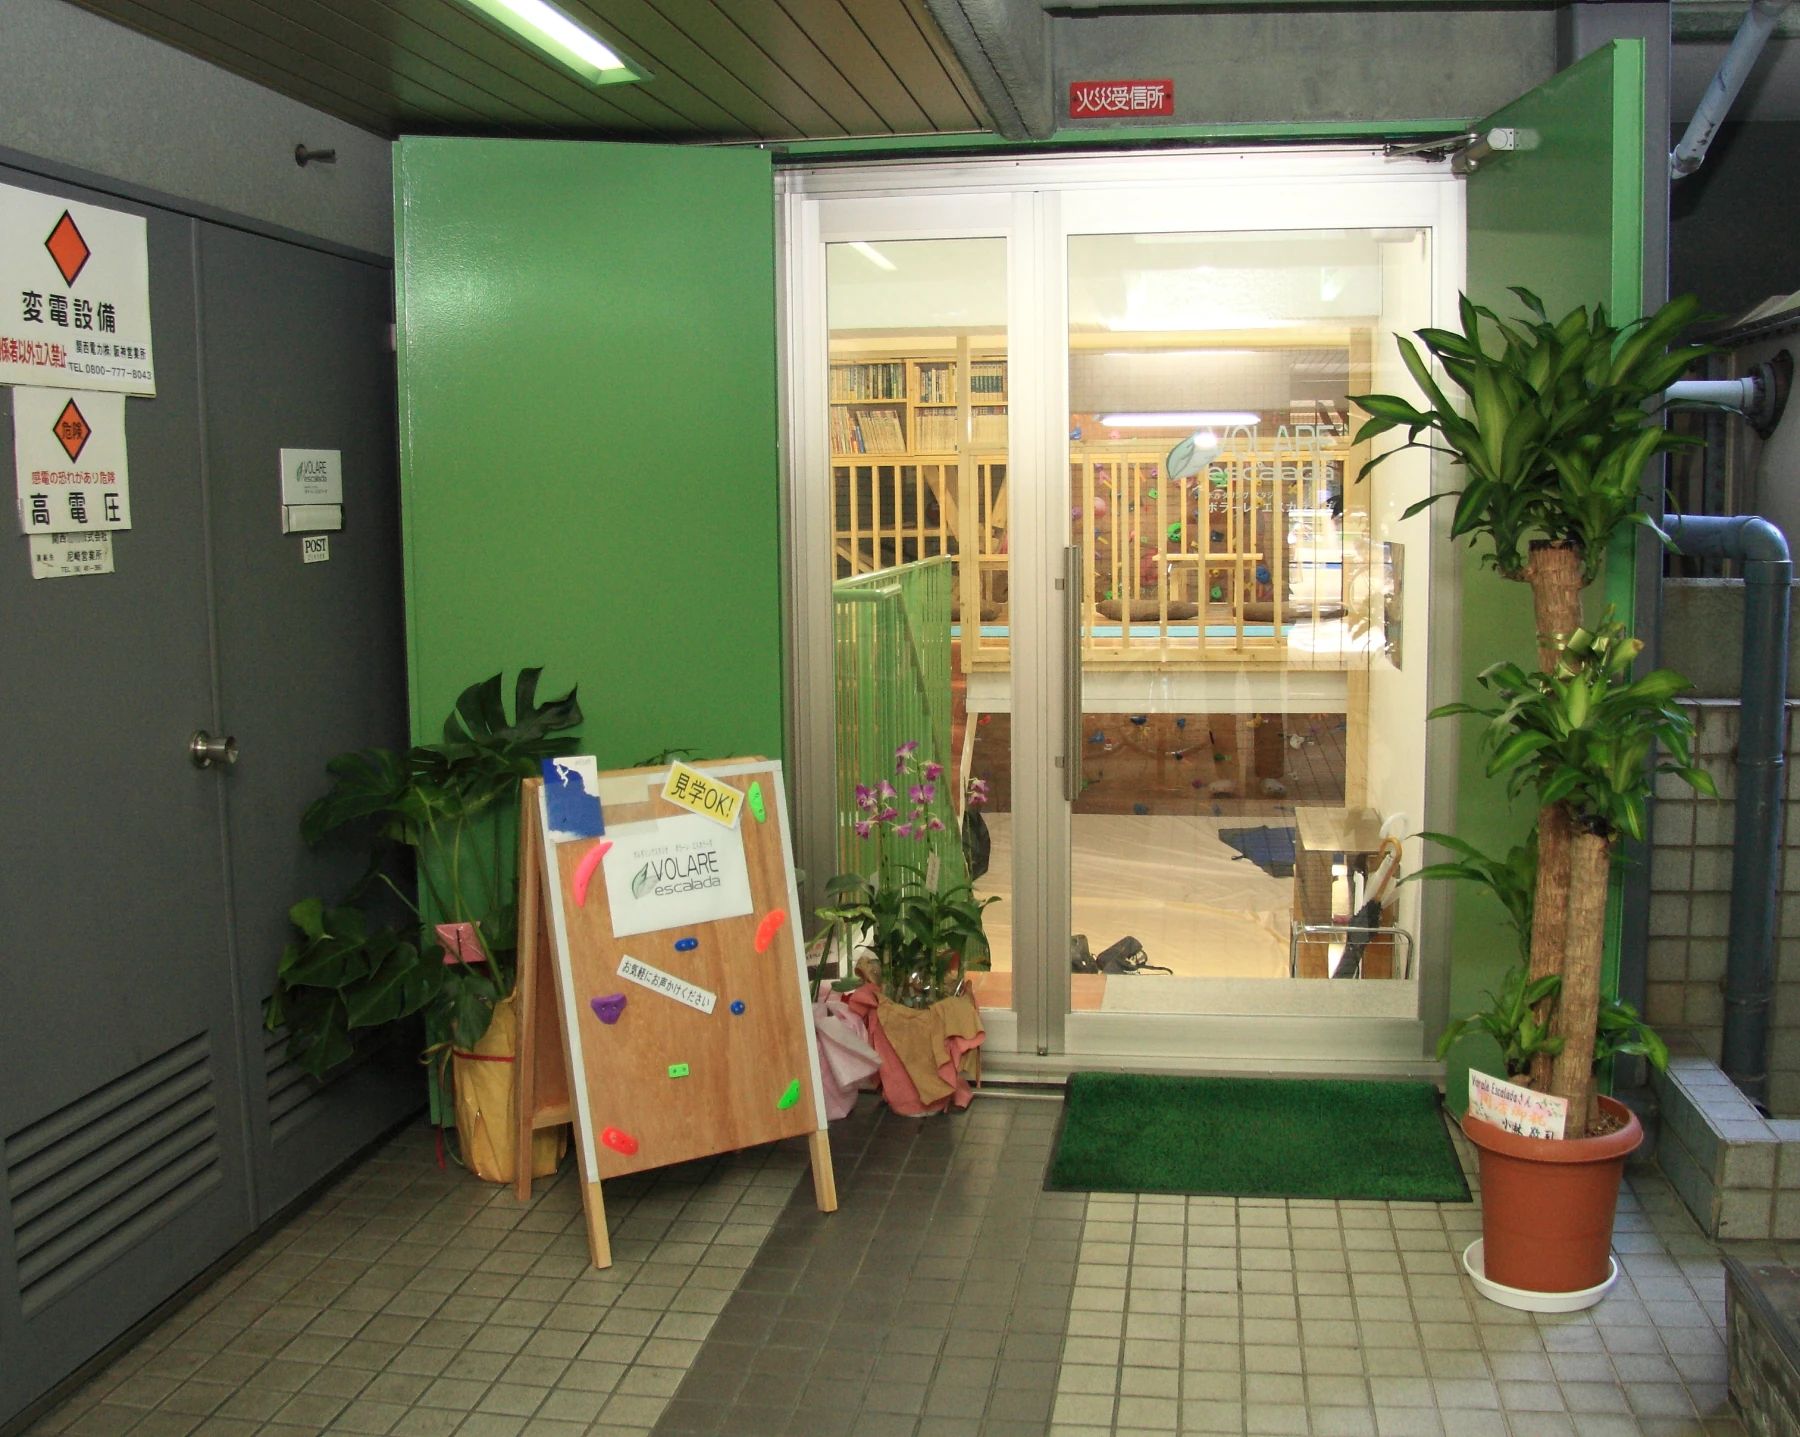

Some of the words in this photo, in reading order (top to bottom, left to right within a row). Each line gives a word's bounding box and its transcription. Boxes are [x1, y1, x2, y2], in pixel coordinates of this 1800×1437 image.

[1077, 85, 1165, 112] 火災受信所
[22, 290, 116, 333] 変電設備
[68, 361, 83, 373] TEL
[85, 363, 152, 380] 0800-777-8043
[62, 421, 82, 440] 危険
[30, 492, 121, 525] 高電圧
[305, 539, 326, 554] POST
[671, 772, 734, 818] 見学OK!
[650, 850, 719, 882] VOLARE
[654, 876, 721, 896] escalada
[622, 961, 711, 1007] お気軽にお声かけください
